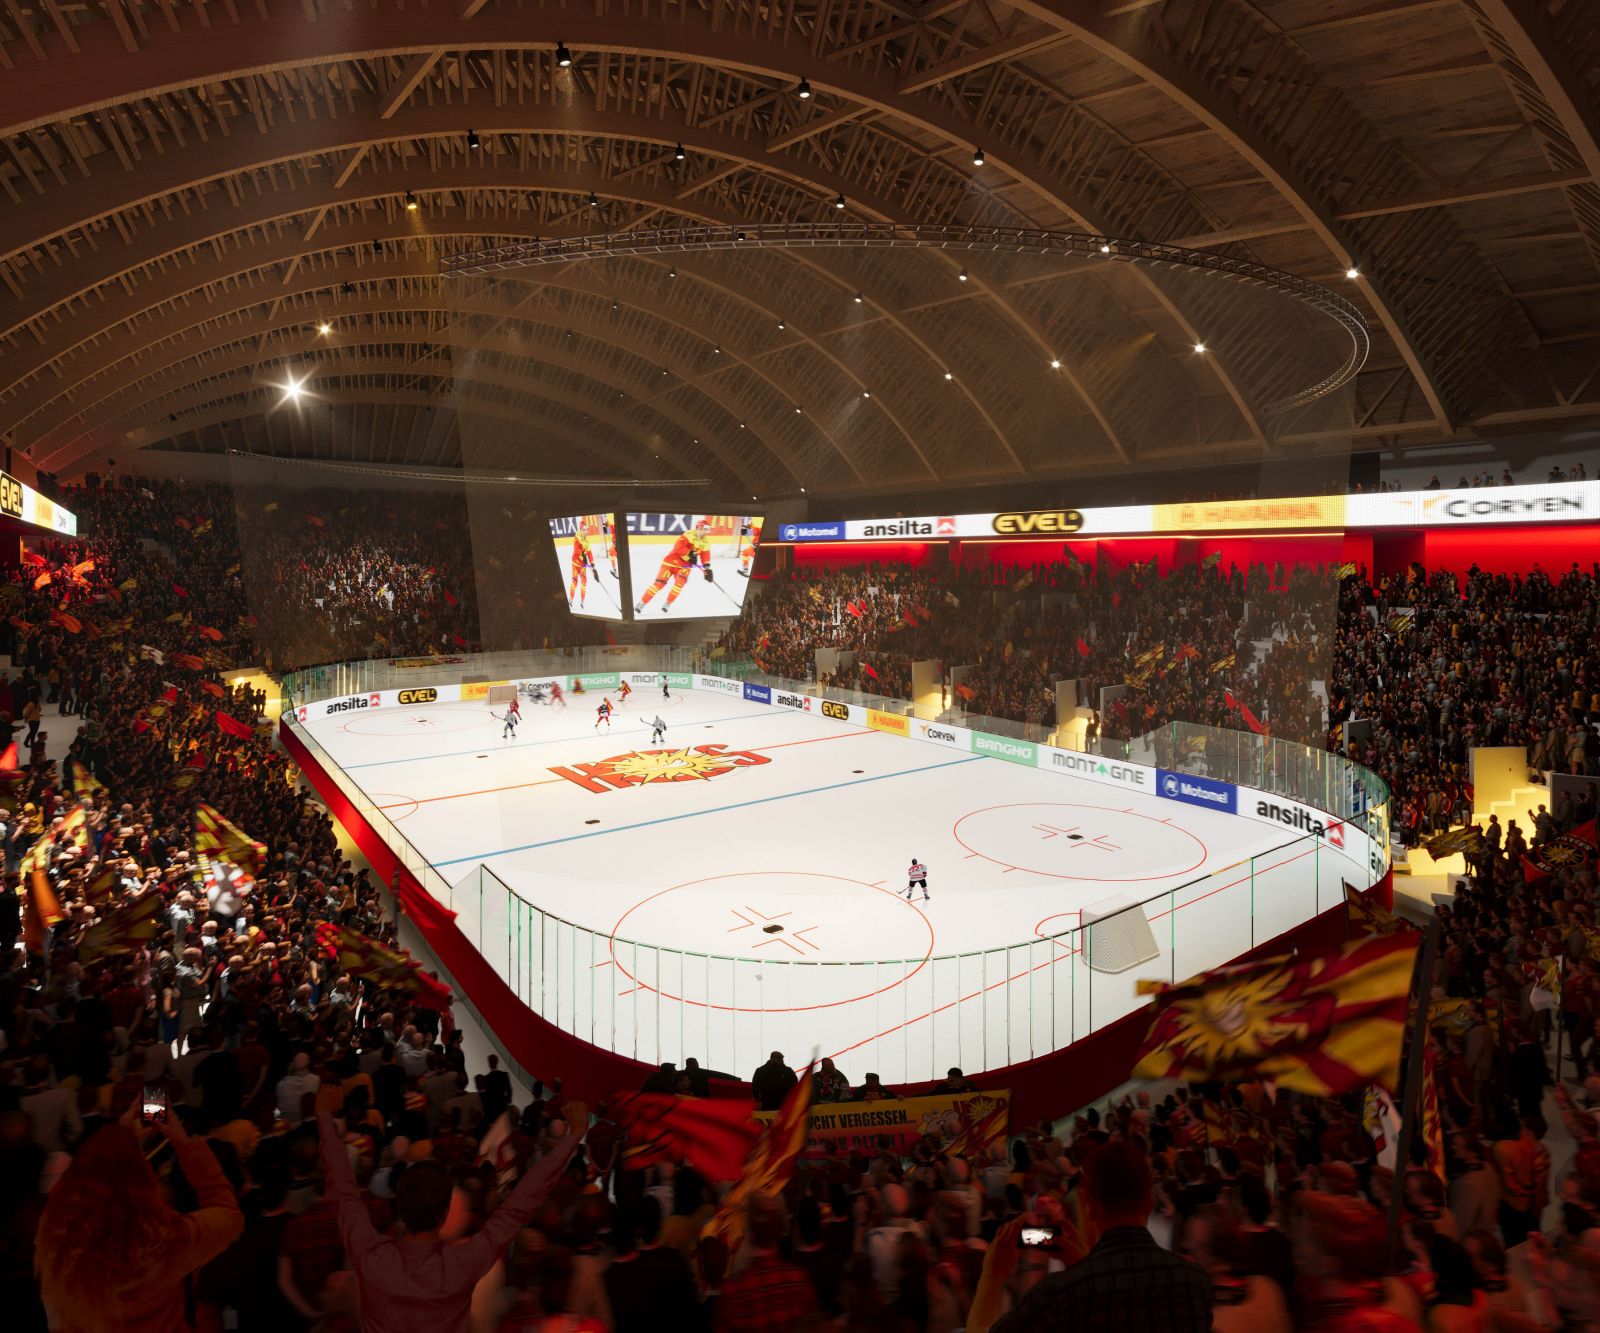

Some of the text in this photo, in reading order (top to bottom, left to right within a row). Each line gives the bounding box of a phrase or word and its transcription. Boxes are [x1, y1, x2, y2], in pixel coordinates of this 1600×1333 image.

[1443, 494, 1584, 517] CORVEN
[863, 518, 932, 536] ansilta
[996, 512, 1075, 532] EVEL
[799, 527, 838, 536] Motomel
[400, 690, 433, 703] EVEL
[777, 694, 803, 709] ansilta
[326, 697, 368, 714] ansilta
[823, 702, 848, 719] EVEL
[927, 728, 956, 743] CORVEN
[1181, 782, 1228, 804] Motomel
[1257, 801, 1325, 838] ansilta
[807, 1110, 917, 1131] ICHT VERGESSEN...
